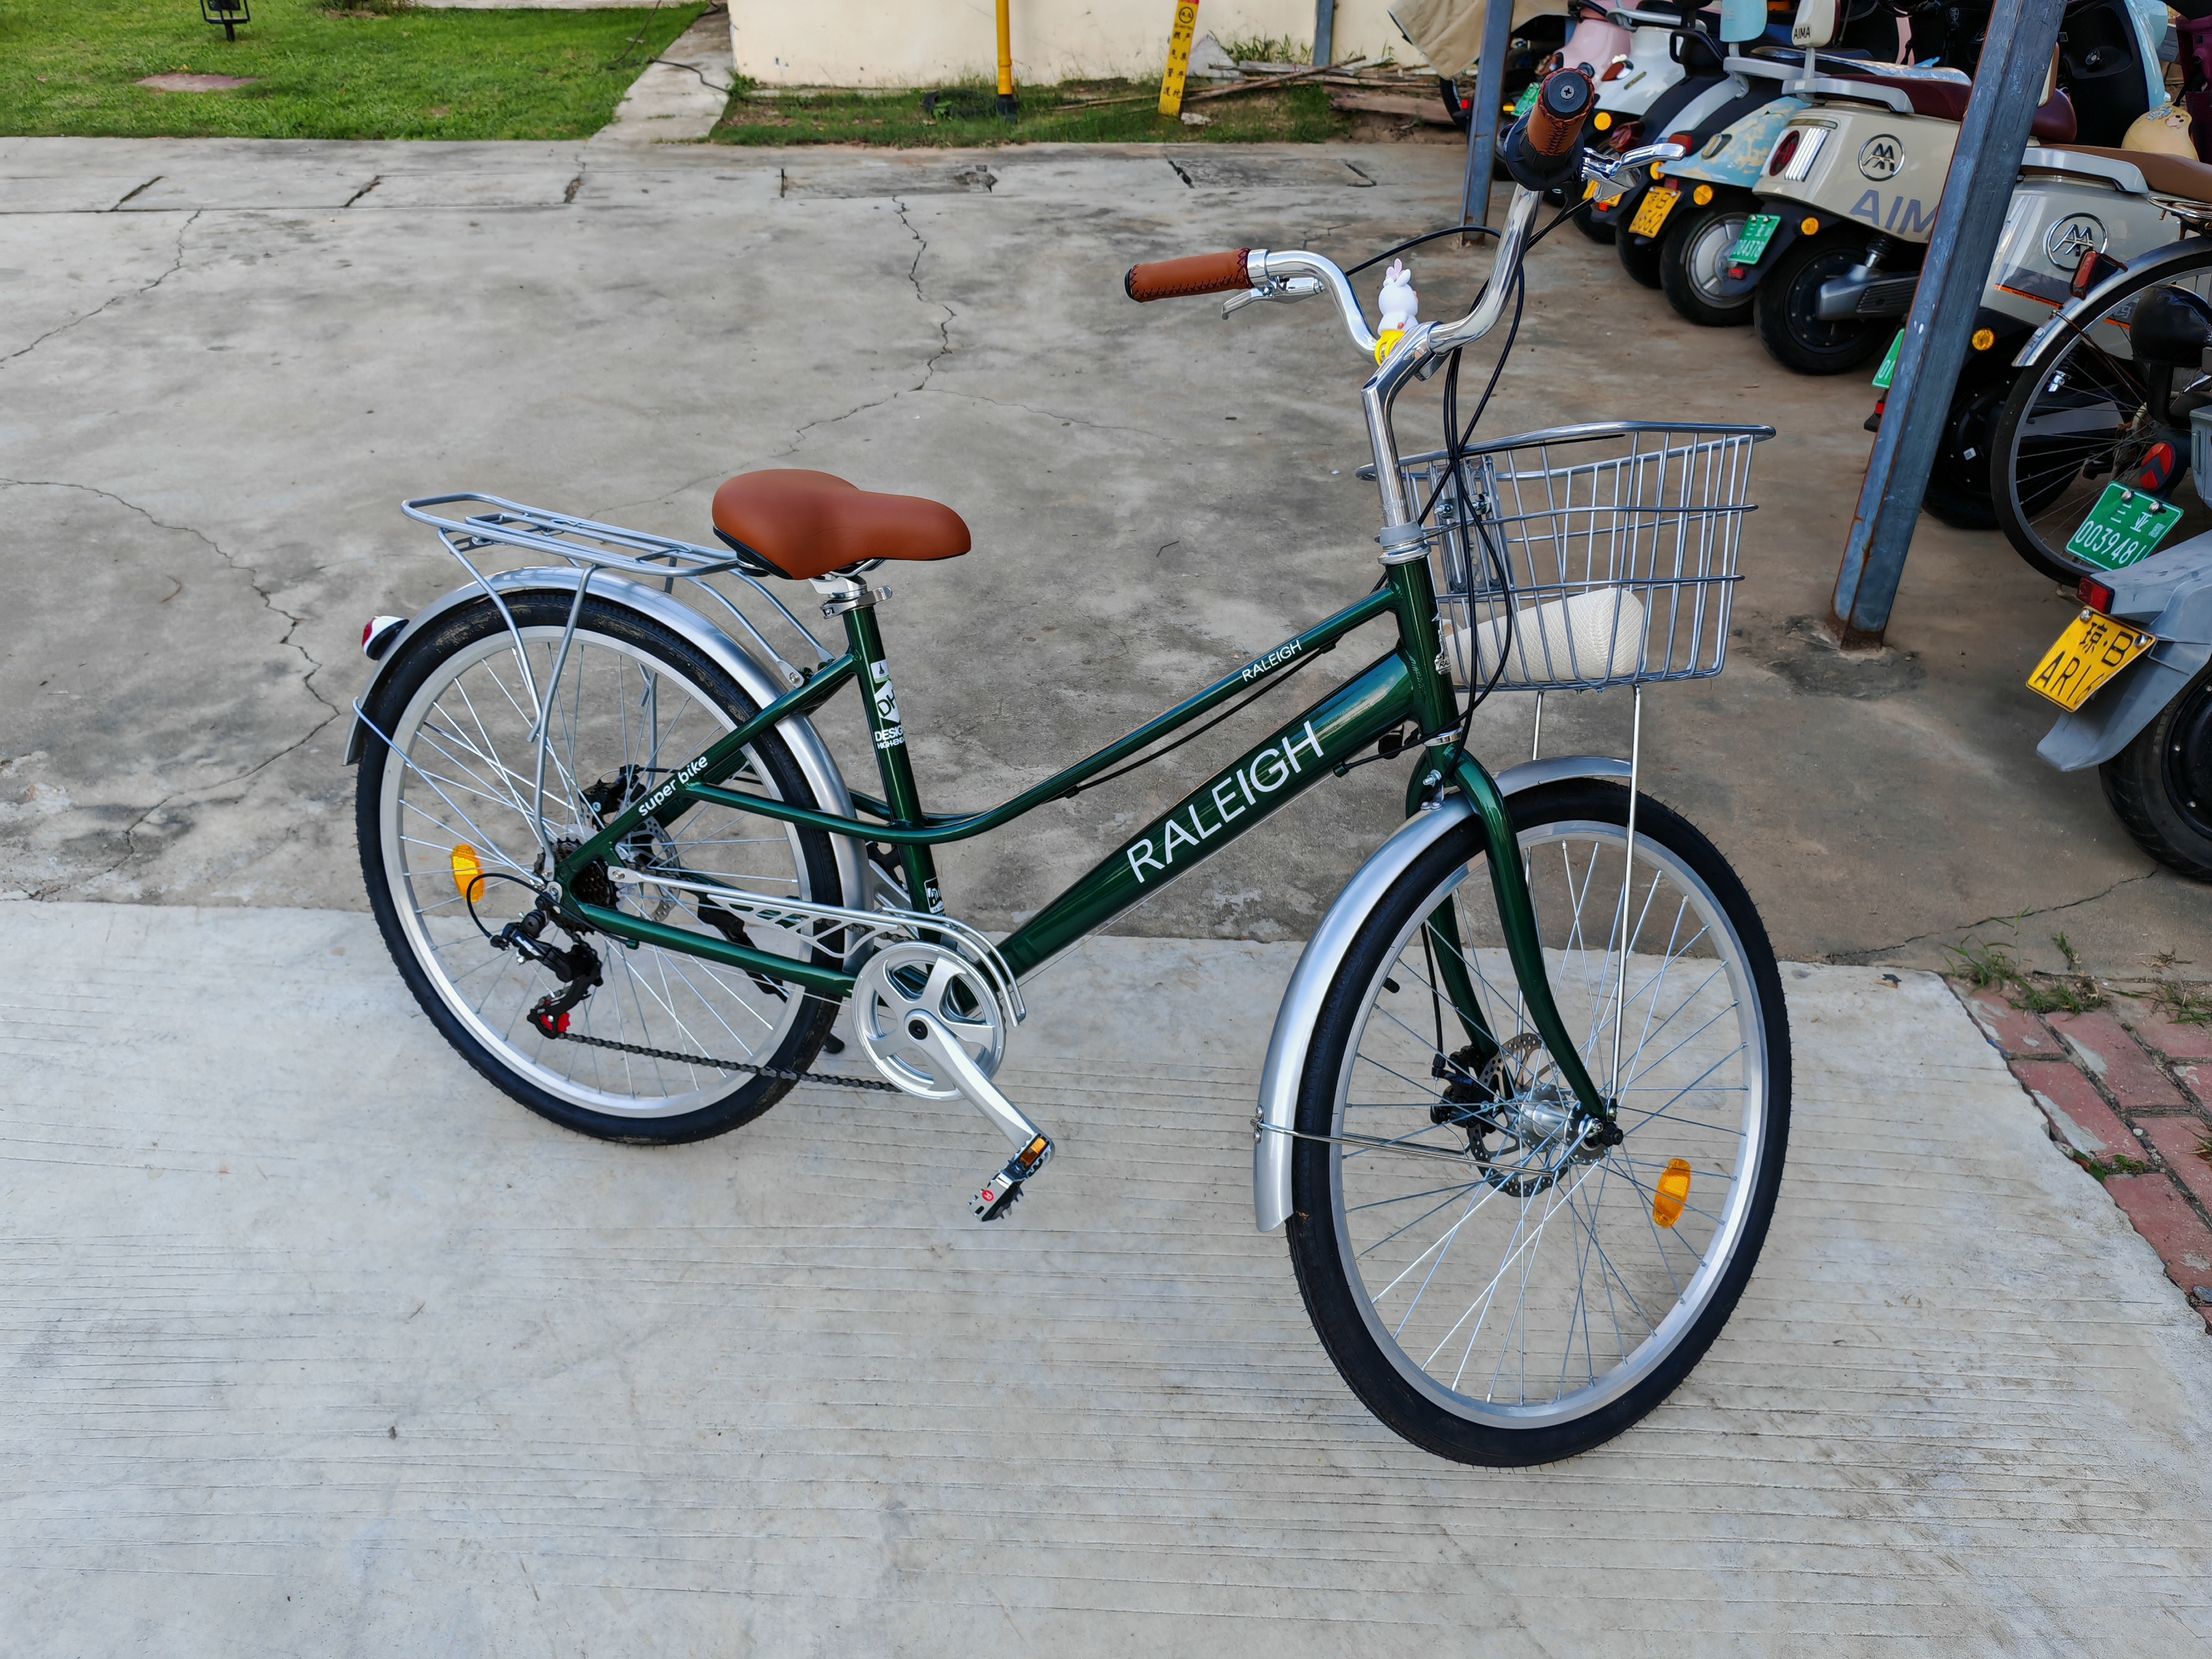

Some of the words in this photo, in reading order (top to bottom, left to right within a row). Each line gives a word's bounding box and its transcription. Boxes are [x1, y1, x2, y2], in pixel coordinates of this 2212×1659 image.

[1793, 26, 1810, 39] AIMA
[1242, 639, 1302, 682] RALEIGH
[638, 779, 676, 817] super
[677, 756, 708, 785] bike
[1127, 720, 1324, 884] RALEIGH
